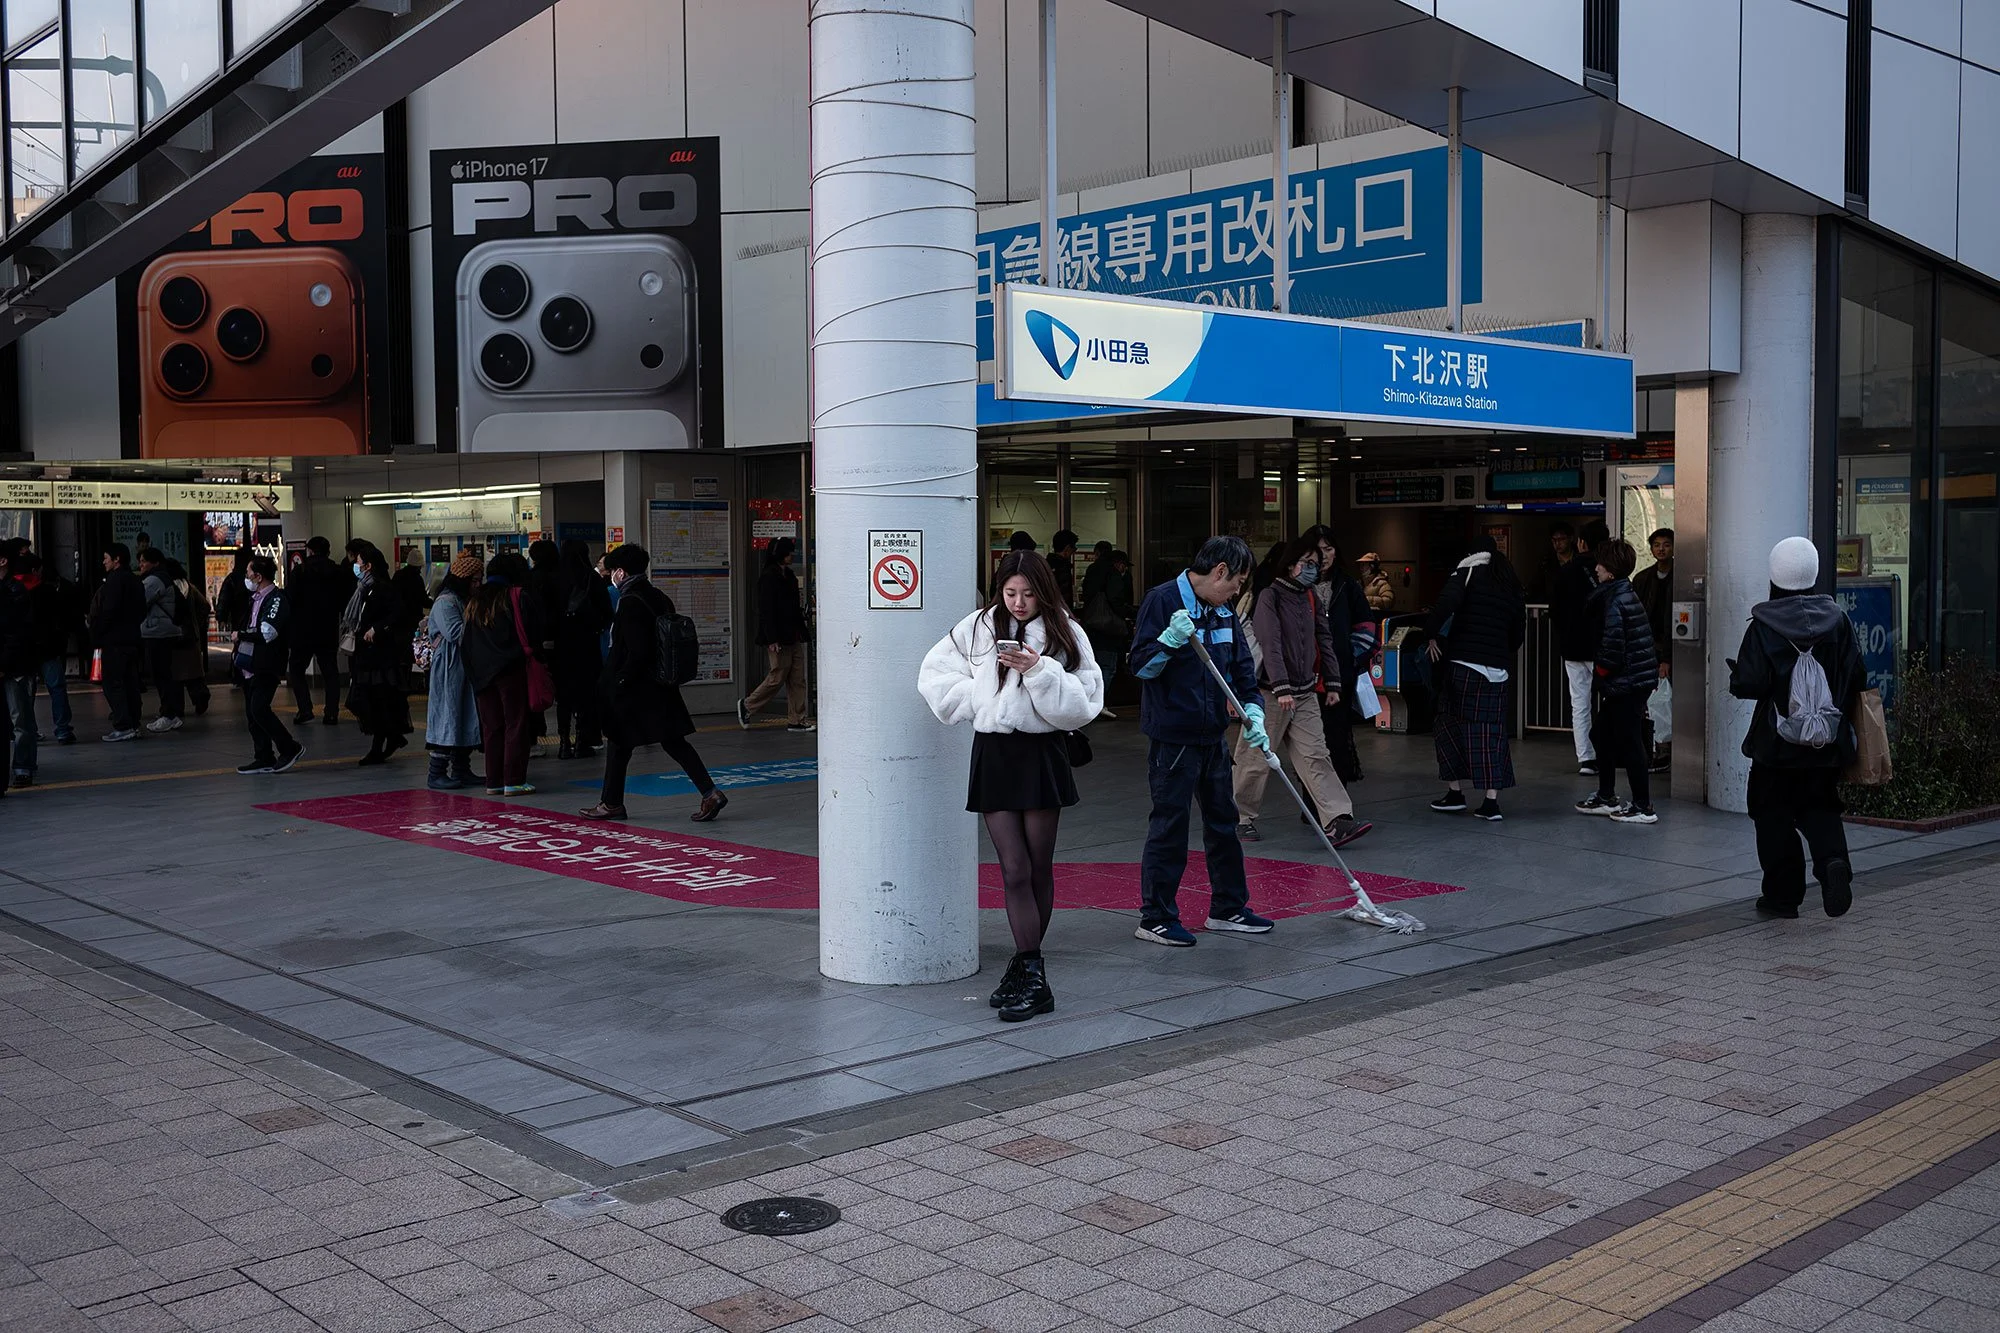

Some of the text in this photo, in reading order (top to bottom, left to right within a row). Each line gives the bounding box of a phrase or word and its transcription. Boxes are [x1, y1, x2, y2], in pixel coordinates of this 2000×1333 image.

[465, 157, 549, 178] iPhone 17
[669, 150, 697, 164] au
[337, 166, 363, 180] au
[452, 173, 698, 236] PRO
[187, 188, 364, 245] RO
[1086, 337, 1150, 365] 小田急
[1383, 343, 1489, 390] 下北沢駅
[1383, 387, 1498, 410] Shimo-Kitazawa Station
[873, 539, 918, 547] 路上喫煙禁止
